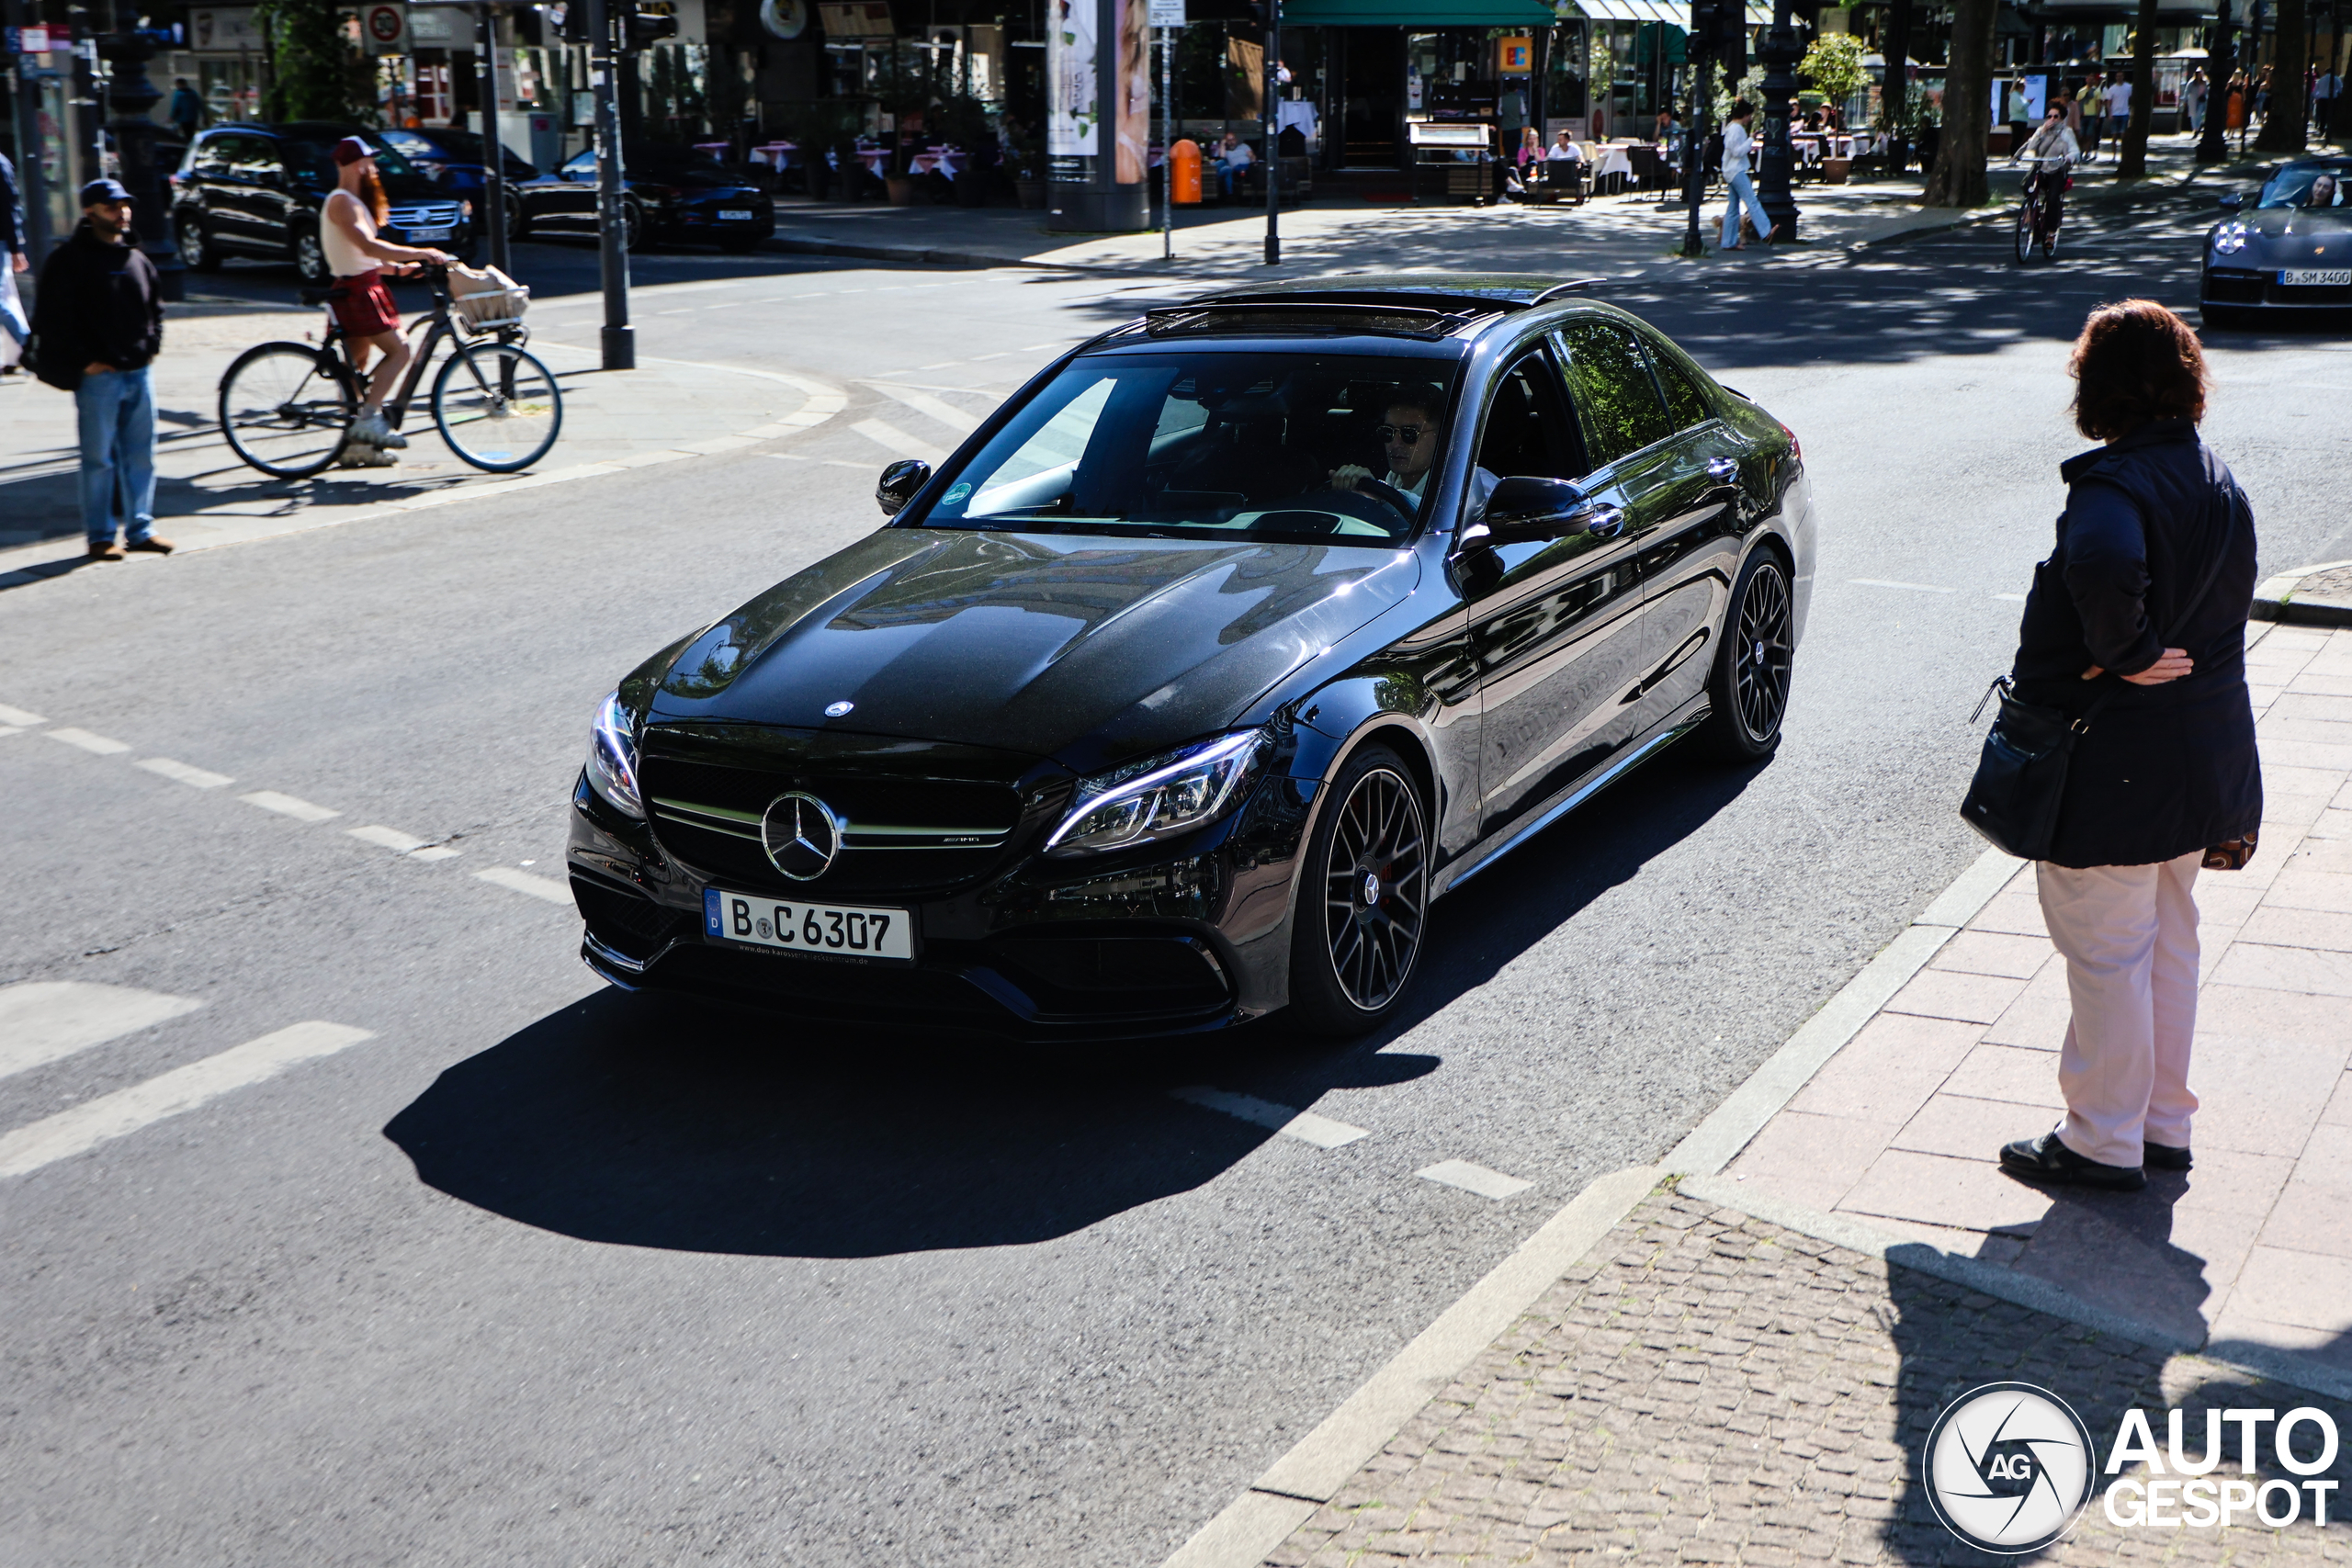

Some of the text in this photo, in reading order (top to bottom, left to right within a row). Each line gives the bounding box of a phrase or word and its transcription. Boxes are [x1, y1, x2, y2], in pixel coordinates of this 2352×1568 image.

[2285, 272, 2349, 284] B SM 3400
[711, 917, 718, 929] D
[732, 898, 890, 952] B C 6307
